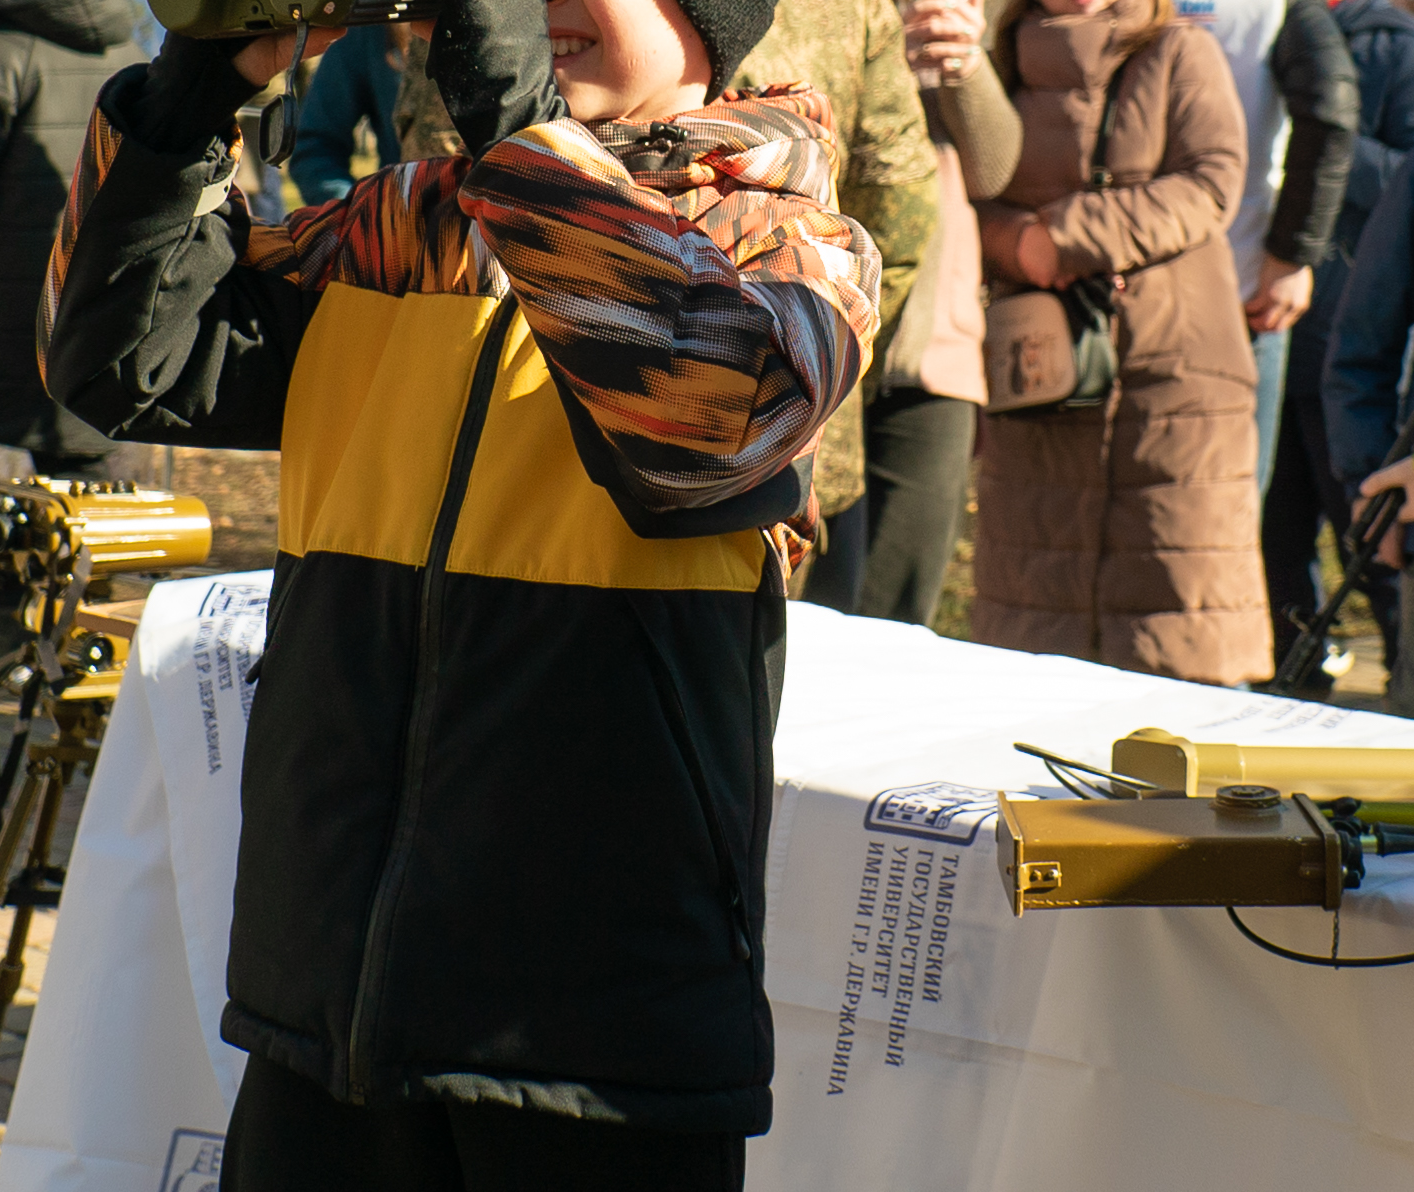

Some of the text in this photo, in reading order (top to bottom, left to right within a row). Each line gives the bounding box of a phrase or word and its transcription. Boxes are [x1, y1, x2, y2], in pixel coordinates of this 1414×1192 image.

[827, 841, 885, 1096] ИМЕНИ Г.Р. ДЕРЖАВИНА
[872, 845, 909, 998] УНИВЕРСИТЕТ
[885, 849, 934, 1067] ГОСУДАРСТВЕННЫЙ
[922, 854, 961, 1003] ТАМБОВСКИЙ
